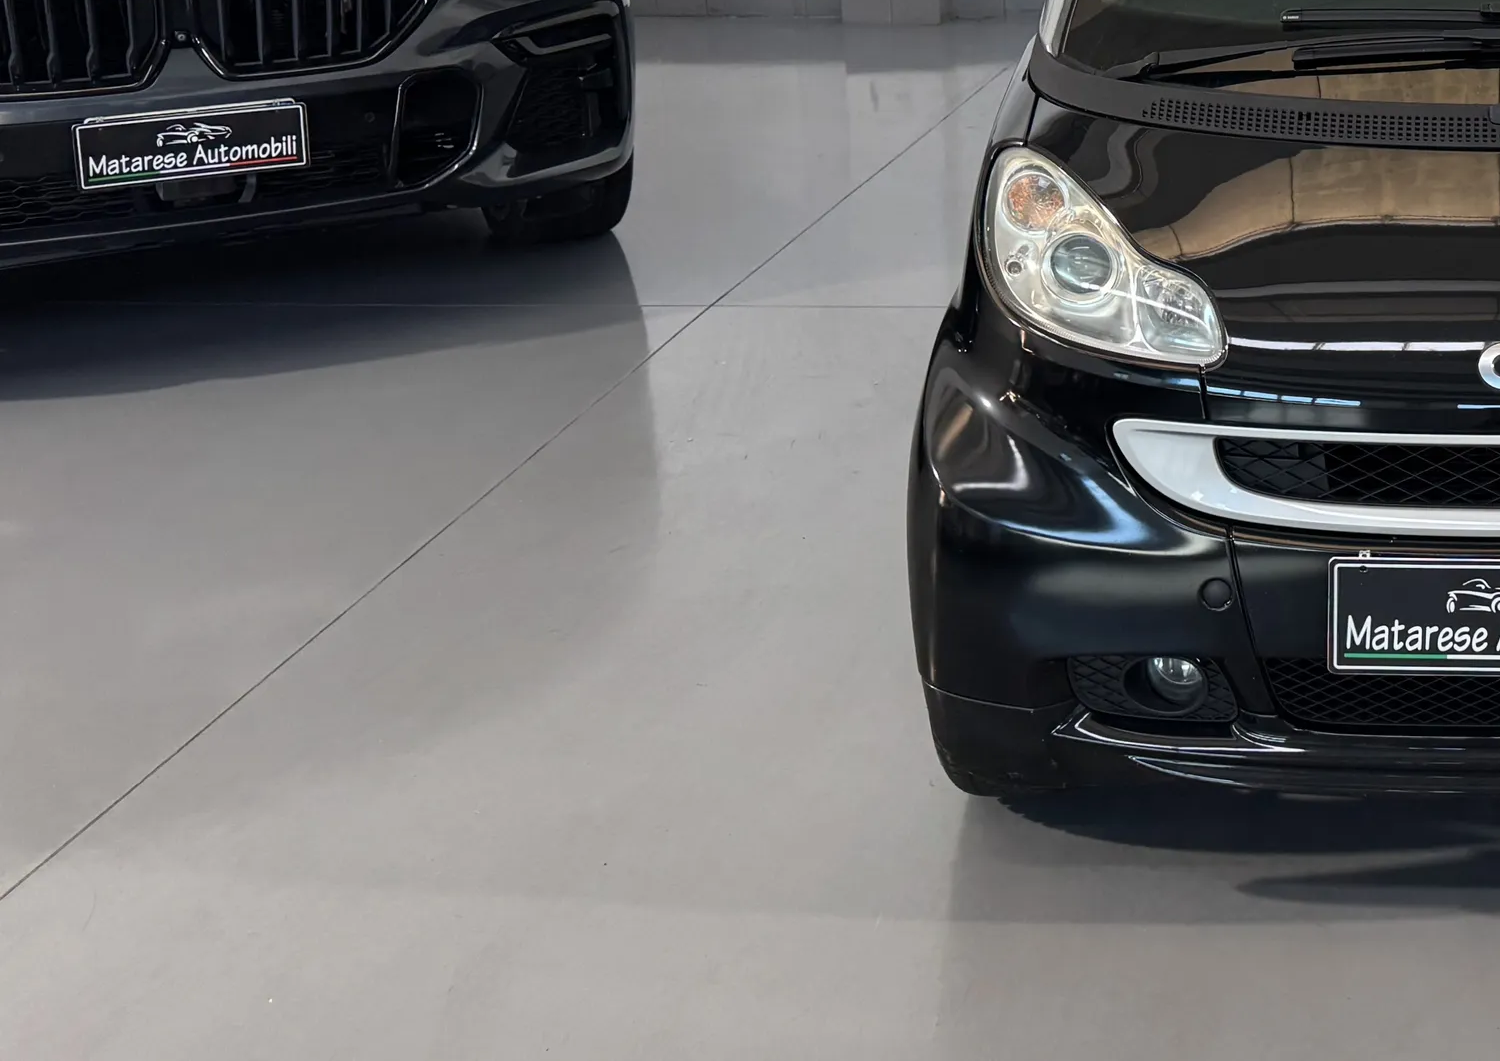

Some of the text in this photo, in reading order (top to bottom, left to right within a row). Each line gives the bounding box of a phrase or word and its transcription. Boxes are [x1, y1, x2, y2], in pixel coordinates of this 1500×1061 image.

[88, 134, 297, 177] Matarese Automobili
[1345, 614, 1489, 653] Matarese
